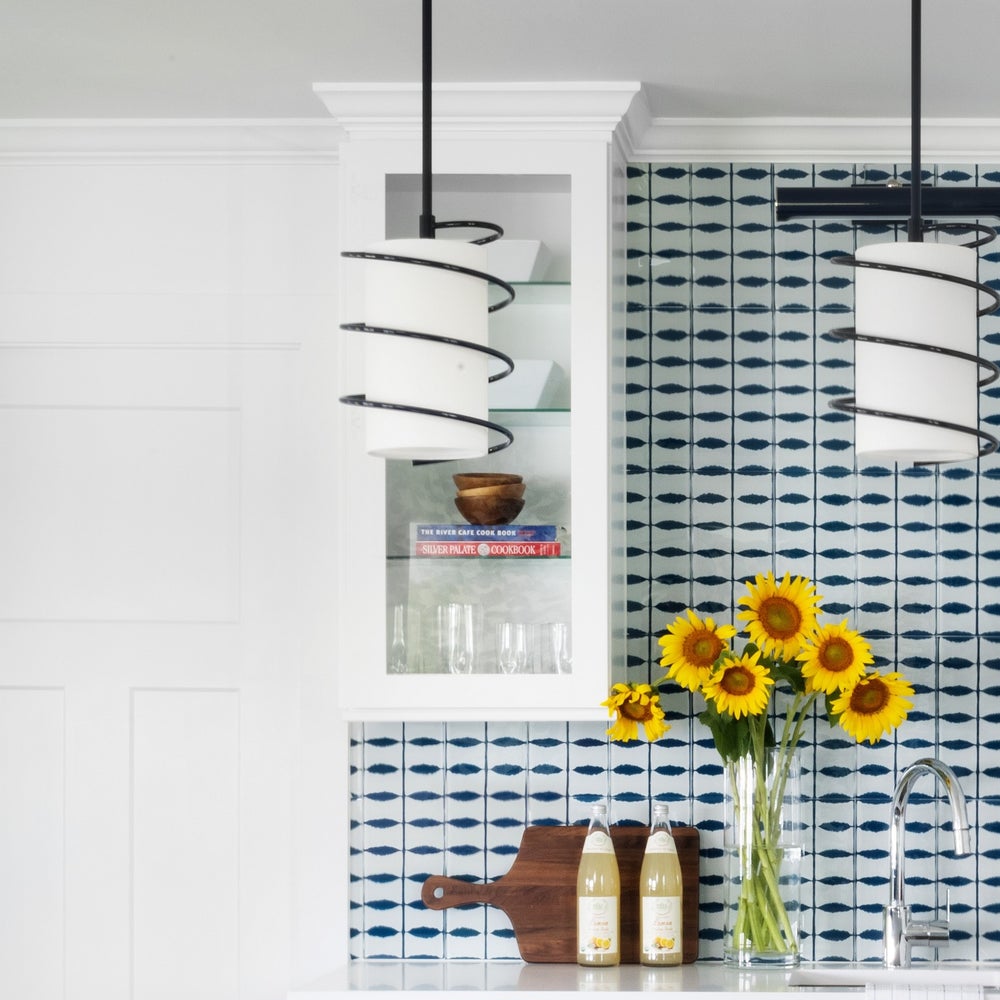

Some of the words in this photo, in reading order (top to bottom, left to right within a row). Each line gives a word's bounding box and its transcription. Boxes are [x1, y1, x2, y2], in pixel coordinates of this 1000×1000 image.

[422, 544, 448, 554] SILVER
[450, 545, 477, 555] PALATE
[491, 545, 536, 555] COOKBOOK
